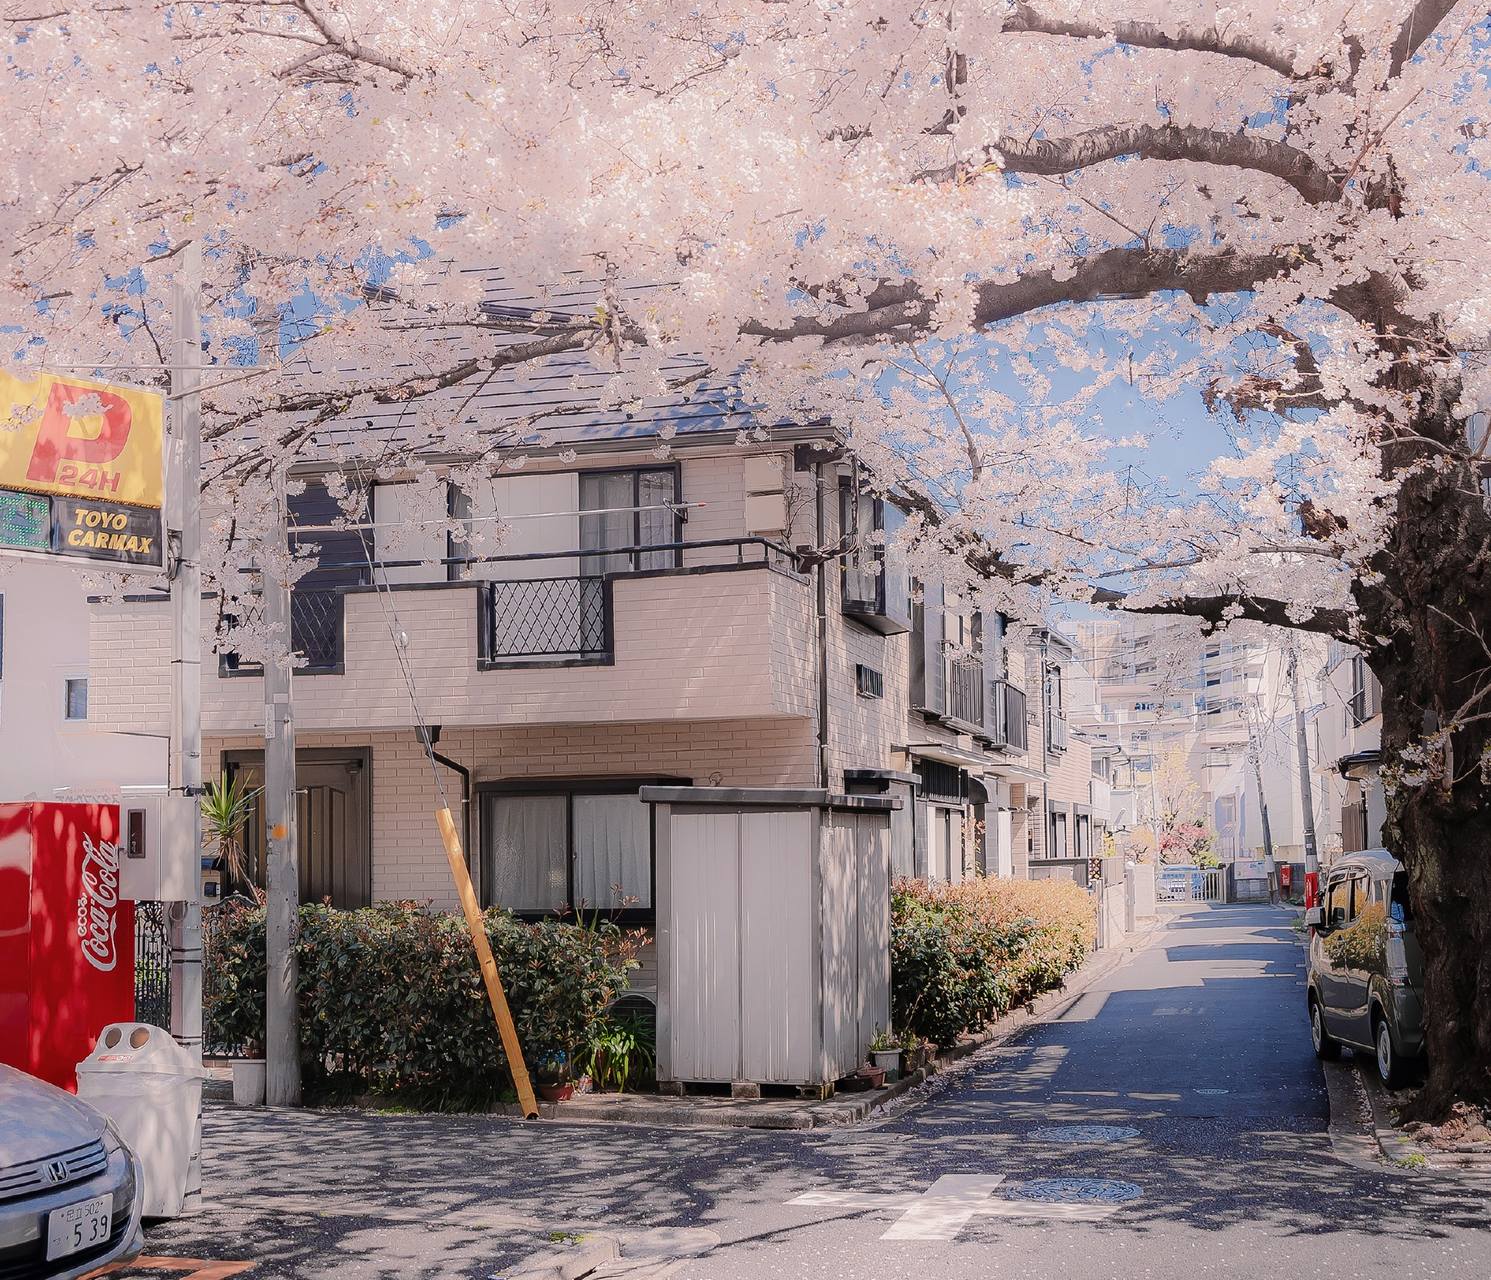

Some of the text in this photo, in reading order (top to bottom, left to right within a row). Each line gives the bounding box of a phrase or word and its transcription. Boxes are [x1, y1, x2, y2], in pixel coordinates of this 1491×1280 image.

[26, 382, 132, 483] P
[59, 464, 121, 492] 24H
[75, 508, 128, 531] TOYO
[68, 529, 153, 554] CARMAX
[81, 831, 119, 972] Coca-Cola
[84, 1201, 100, 1217] 502
